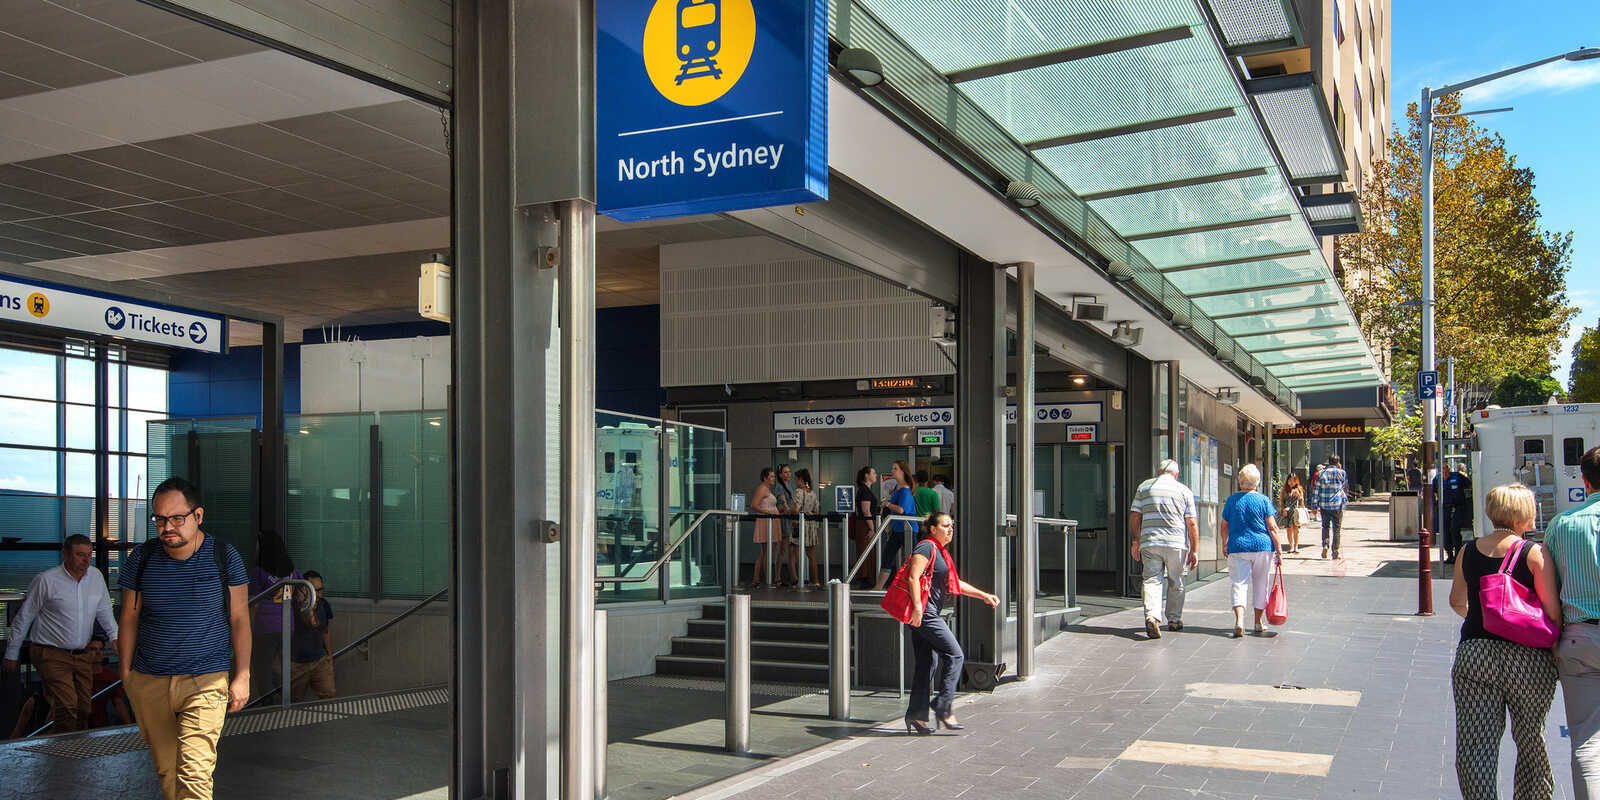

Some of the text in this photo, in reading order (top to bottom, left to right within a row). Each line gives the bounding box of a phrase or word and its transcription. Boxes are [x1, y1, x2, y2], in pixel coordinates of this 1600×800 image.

[618, 143, 784, 181] North Sydney
[128, 313, 185, 337] Tickets
[1425, 375, 1433, 385] P
[792, 412, 929, 425] Tickets Tickets
[1324, 424, 1364, 434] Coffees
